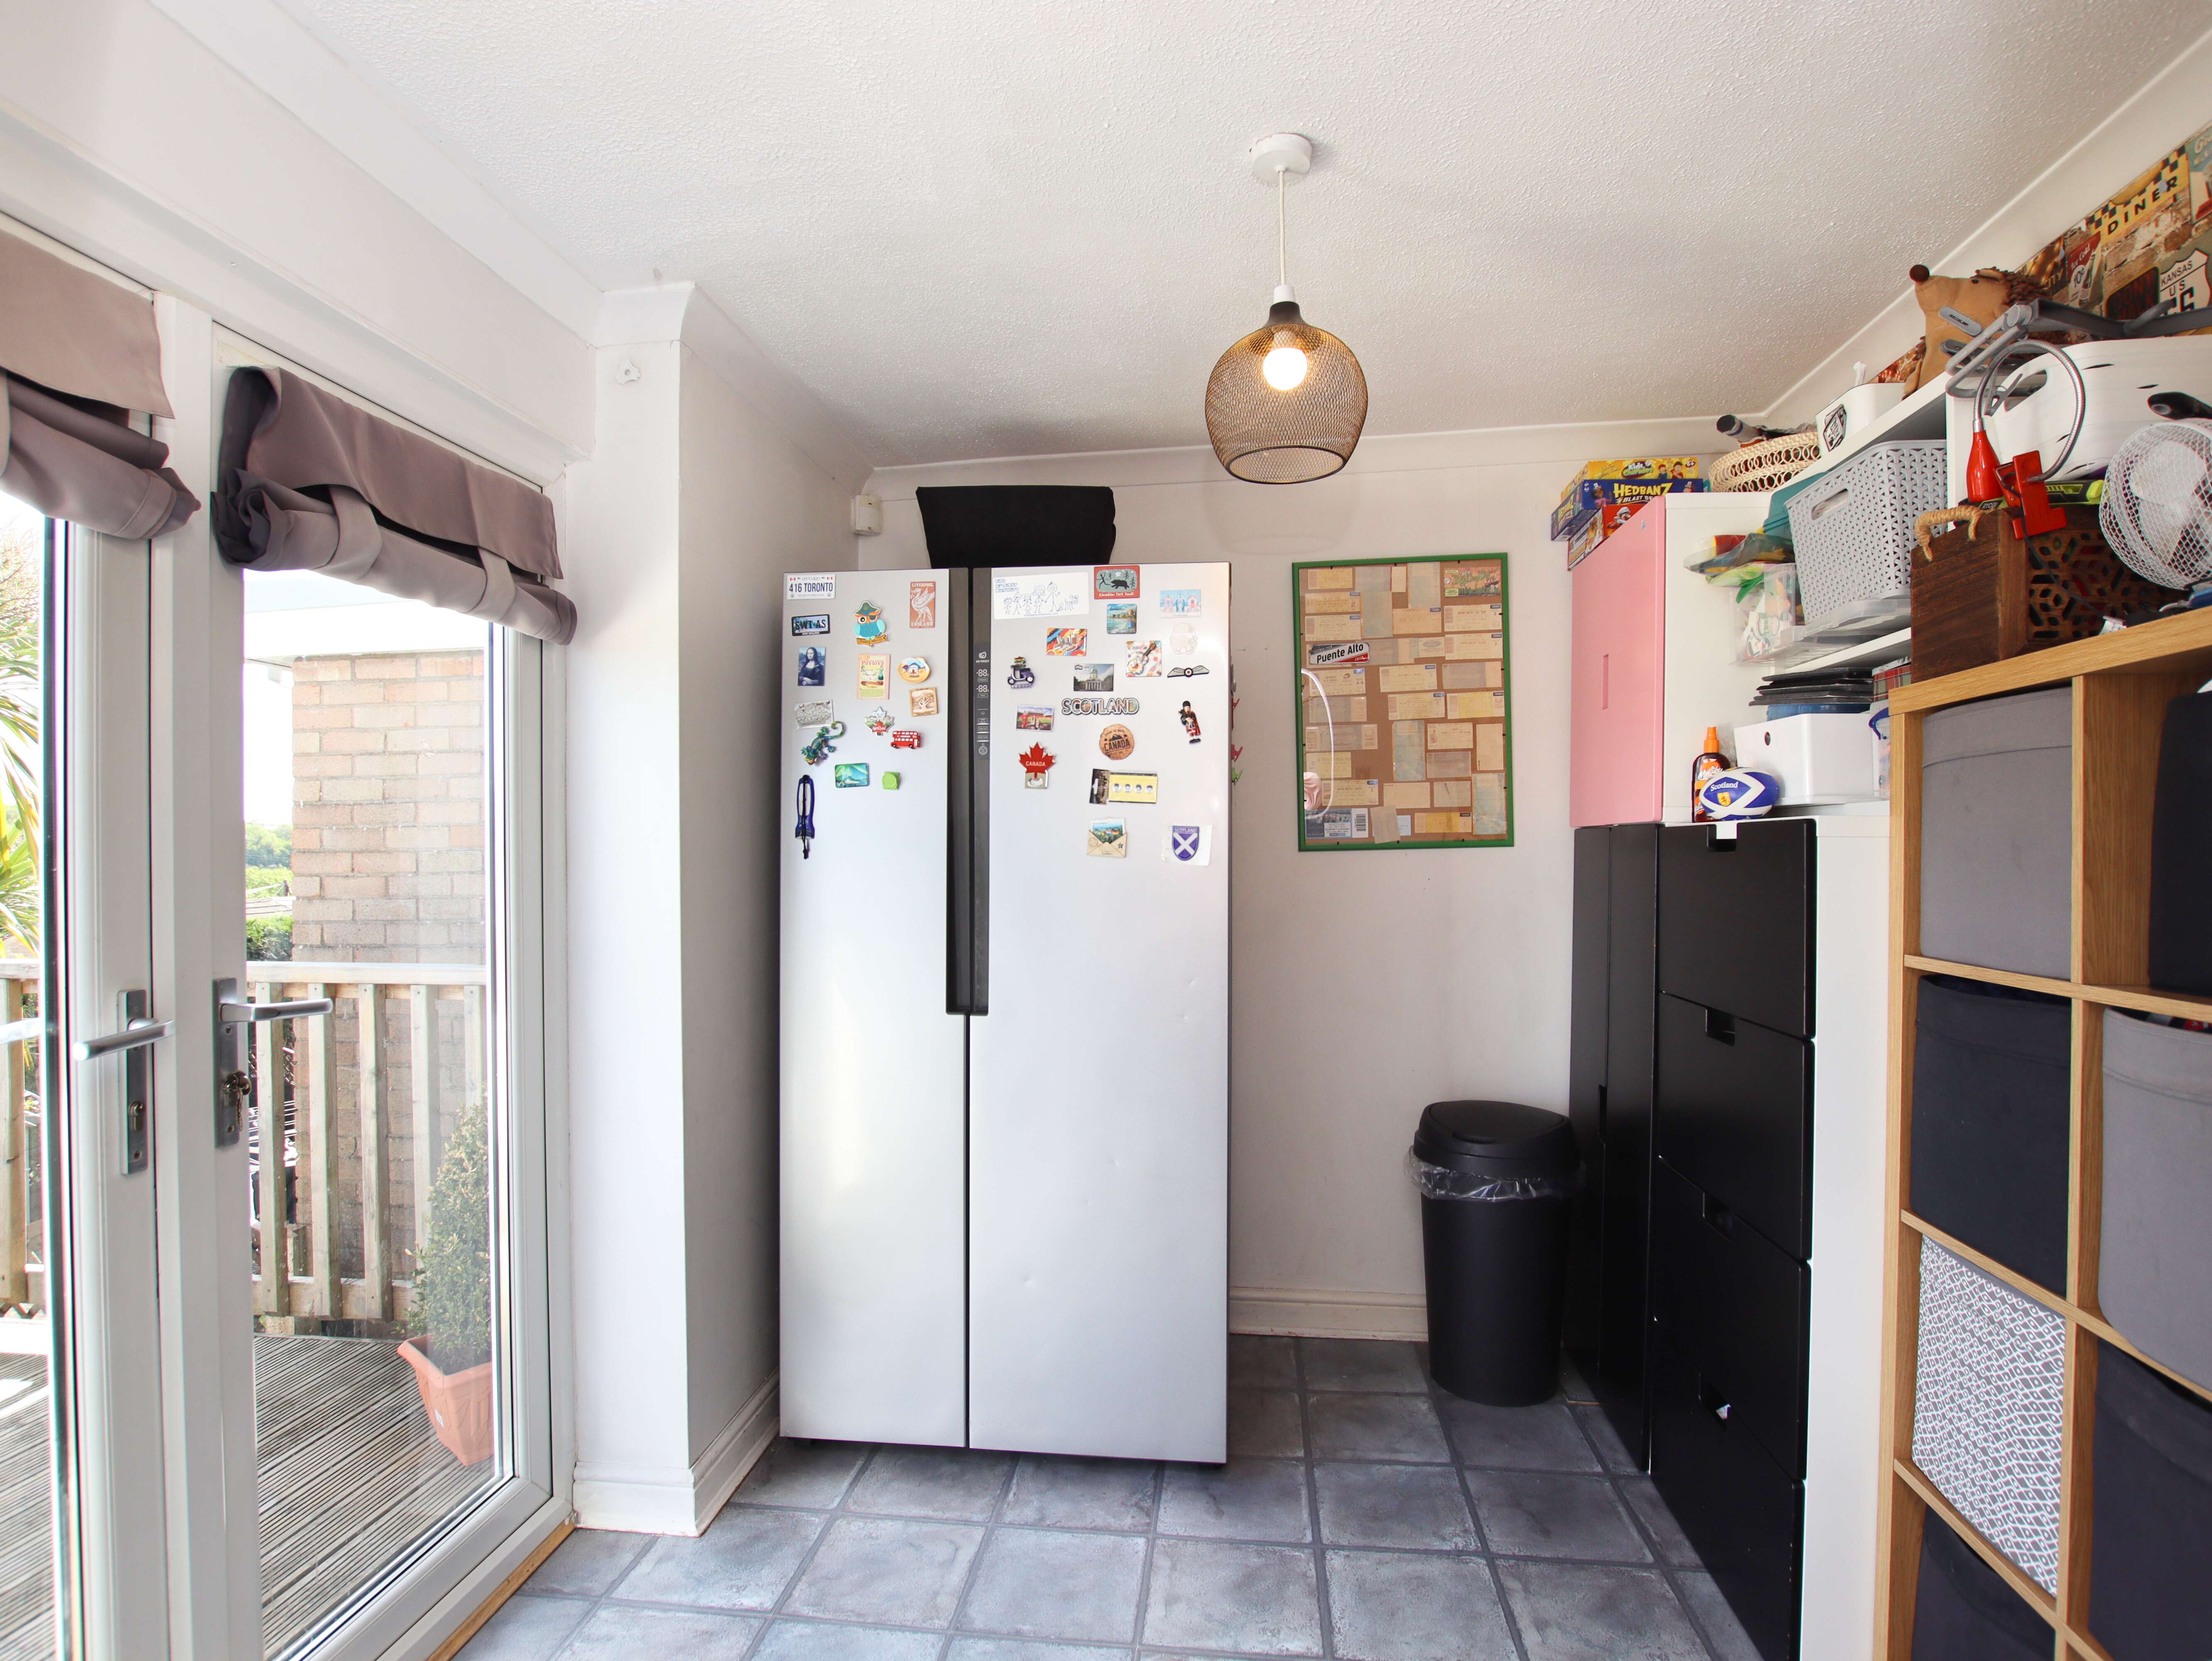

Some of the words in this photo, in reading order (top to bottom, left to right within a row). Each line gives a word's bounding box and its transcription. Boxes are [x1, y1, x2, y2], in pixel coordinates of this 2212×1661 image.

[2107, 176, 2178, 235] DINER
[2079, 243, 2090, 261] Cold
[2161, 260, 2192, 287] KANSAS
[2169, 285, 2176, 296] U
[2179, 280, 2185, 291] S
[1613, 482, 1673, 498] HEDBANZ
[789, 583, 802, 593] 416
[804, 583, 833, 592] TORONTO
[1317, 649, 1345, 664] Puente
[1348, 643, 1363, 654] Alto
[1062, 698, 1139, 715] SCOTLAND
[1104, 739, 1130, 752] CANADA
[1710, 782, 1739, 791] Scotland
